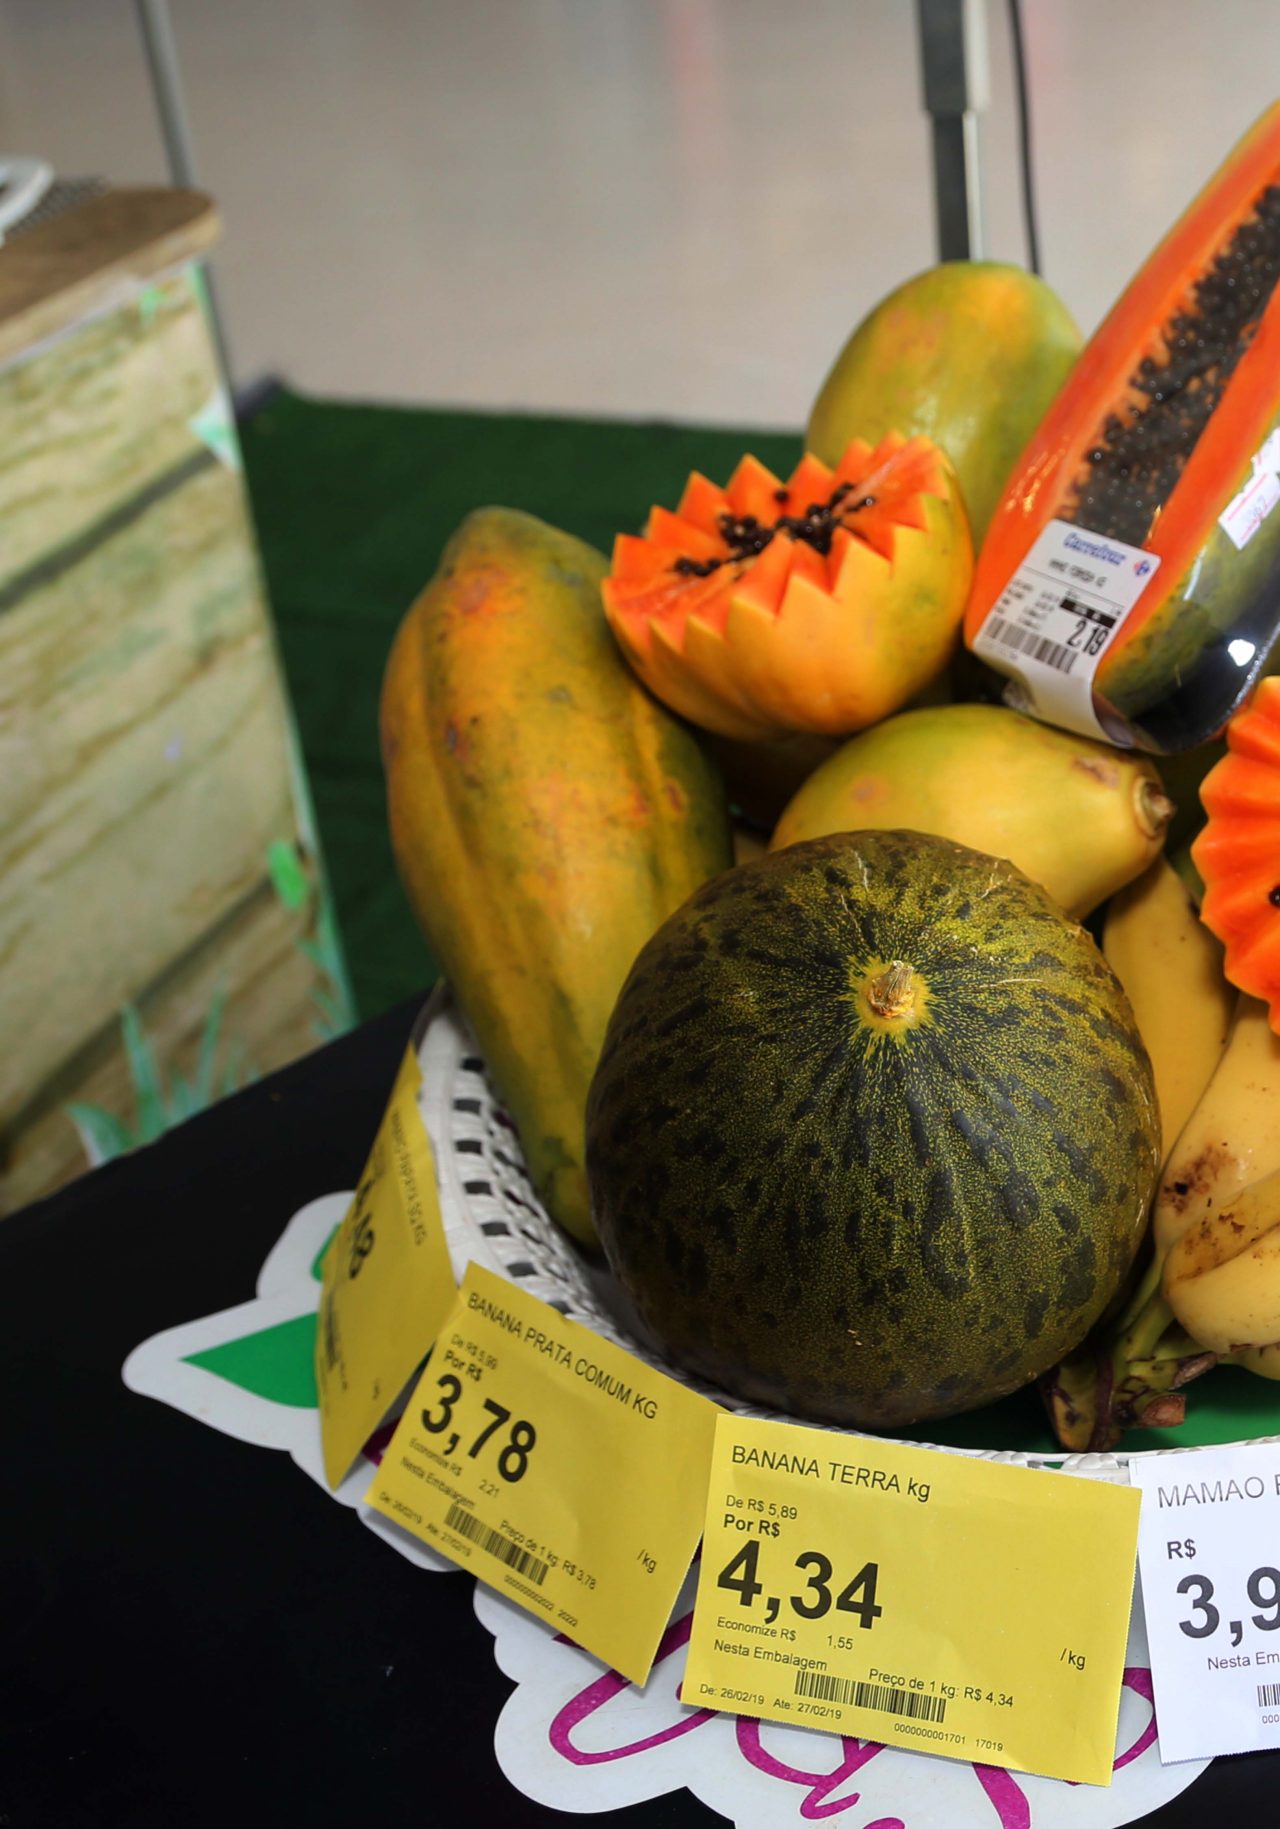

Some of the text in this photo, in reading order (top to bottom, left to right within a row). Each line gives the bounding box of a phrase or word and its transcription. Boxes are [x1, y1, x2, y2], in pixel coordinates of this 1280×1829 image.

[443, 1349, 483, 1382] Por R$
[467, 1291, 658, 1419] BANANA PRATA COMUM KG
[420, 1373, 537, 1483] 3,78
[401, 1455, 476, 1510] Nesta Embalagem
[731, 1444, 931, 1503] BANANA TERRA kg
[725, 1494, 798, 1520] De R$ 5,89
[1157, 1476, 1265, 1508] MAMAO
[723, 1513, 780, 1539] Por R$
[499, 1519, 525, 1542] Preço
[525, 1538, 538, 1552] de
[561, 1559, 577, 1576] R$
[576, 1569, 597, 1590] 3,78
[1166, 1537, 1197, 1560] R$
[716, 1539, 883, 1630] 4,34
[716, 1615, 854, 1650] Economize R$ 1,55
[713, 1638, 828, 1671] Nesta Embalagem
[1207, 1654, 1251, 1671] Nesta
[699, 1683, 842, 1720] De: 26/02/19 Ate: 27/02/19
[868, 1667, 1013, 1708] Preço de 1 kg: R$ 4,34
[893, 1722, 1004, 1752] 0000000001701 17019
